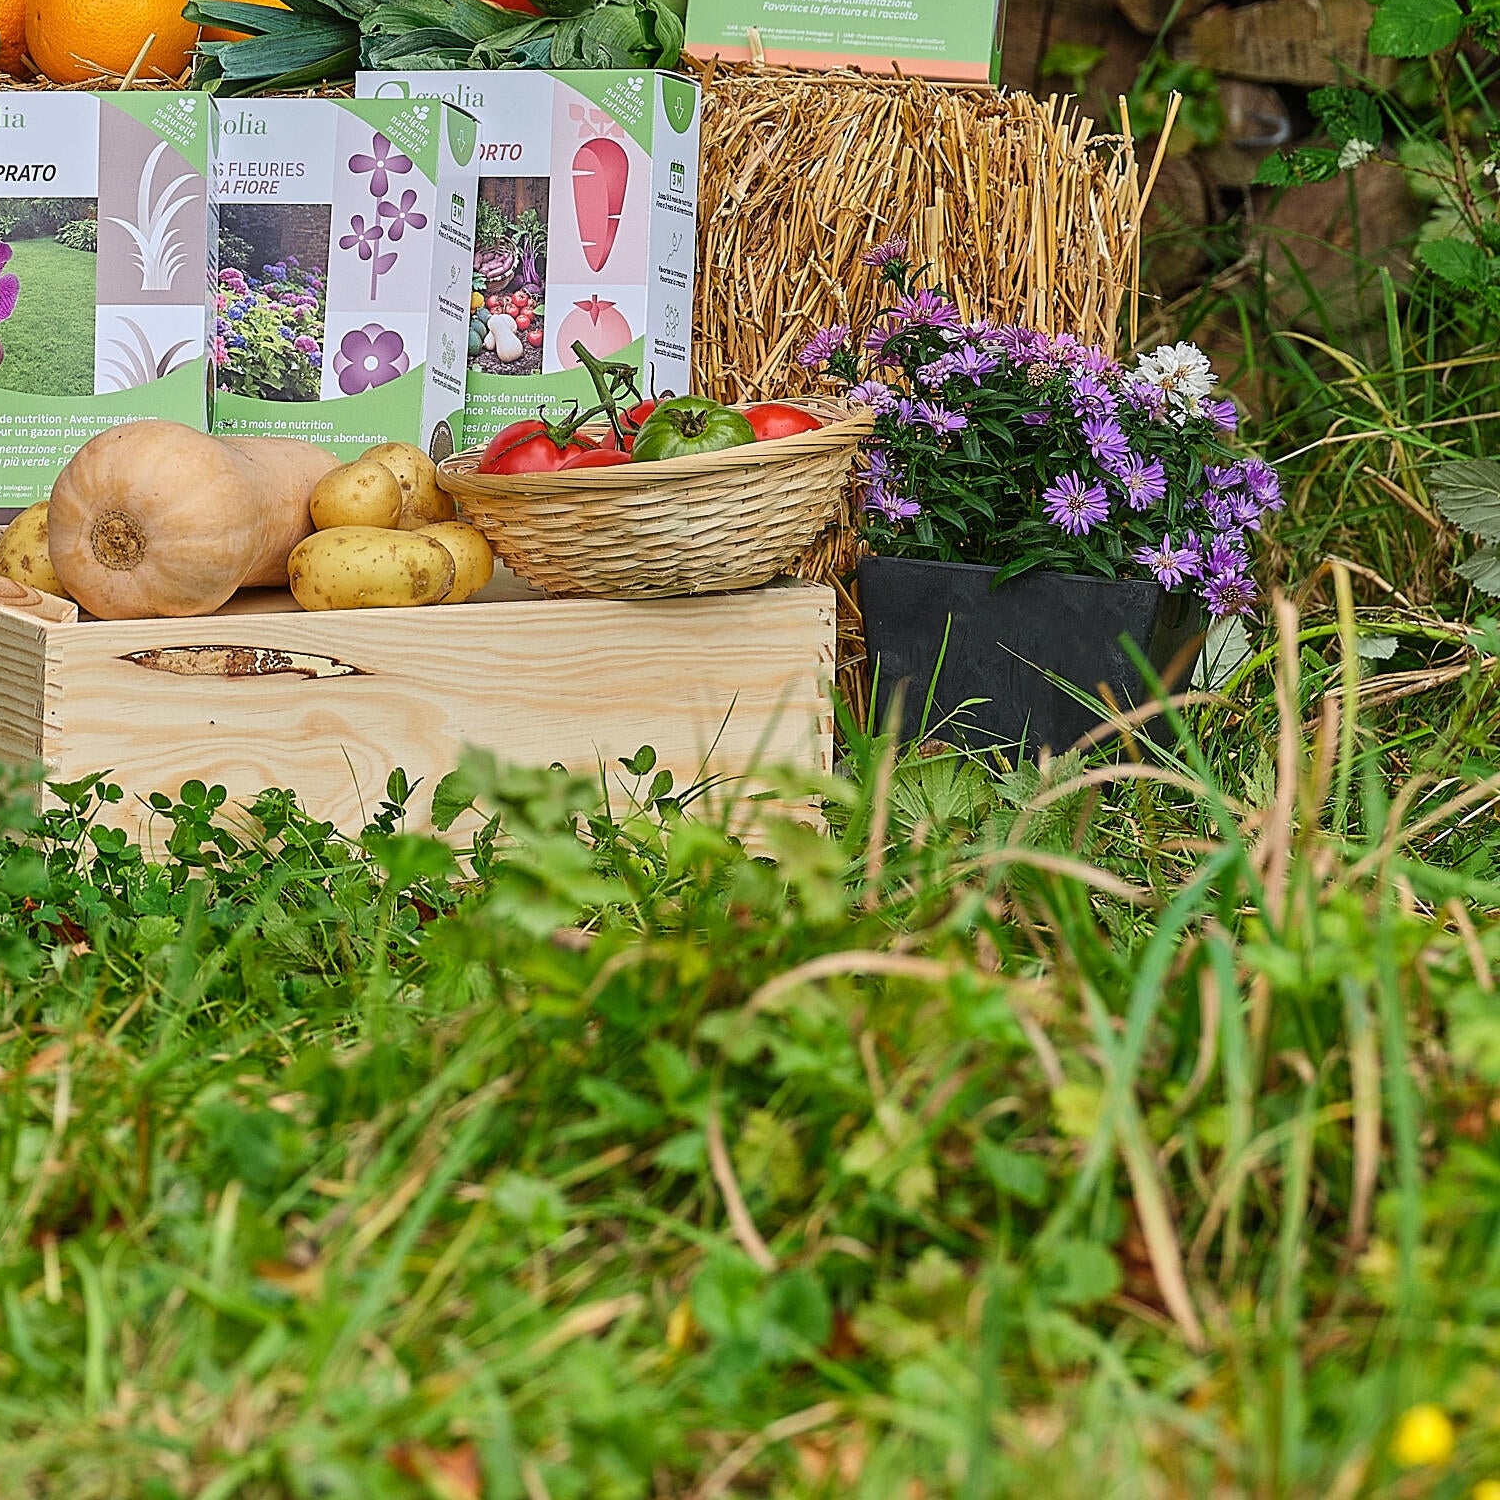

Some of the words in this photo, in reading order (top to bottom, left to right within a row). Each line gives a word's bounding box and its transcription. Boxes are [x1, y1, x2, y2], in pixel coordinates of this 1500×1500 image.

[762, 1, 808, 13] Favorisce
[810, 4, 820, 14] la
[819, 5, 861, 16] fioritura
[862, 9, 868, 17] e
[870, 8, 876, 18] il
[878, 10, 918, 20] raccolto
[605, 88, 643, 118] naturelle
[616, 83, 644, 106] origine
[166, 103, 198, 128] origine
[602, 97, 636, 125] naturale
[151, 118, 190, 146] naturale
[156, 108, 196, 139] naturelle
[391, 116, 428, 147] naturelle
[401, 111, 430, 135] origine
[386, 125, 421, 153] naturale
[229, 163, 304, 176] FLEURIES
[234, 181, 279, 194] FIORE
[466, 393, 470, 402] 3
[473, 393, 496, 402] mois
[498, 393, 510, 402] de
[512, 393, 556, 404] nutrition
[490, 405, 527, 415] Récolte
[0, 414, 12, 423] de
[14, 414, 61, 424] nutrition
[69, 414, 94, 424] Avec
[96, 414, 158, 426] magnési
[240, 419, 246, 428] 3
[248, 419, 272, 429] mois
[274, 419, 286, 429] de
[288, 420, 333, 430] nutrition
[14, 428, 28, 436] un
[30, 428, 62, 438] gazon
[64, 427, 86, 438] plus
[310, 433, 331, 444] plus
[333, 433, 387, 443] abondante
[3, 456, 19, 468] più
[21, 456, 50, 466] verde
